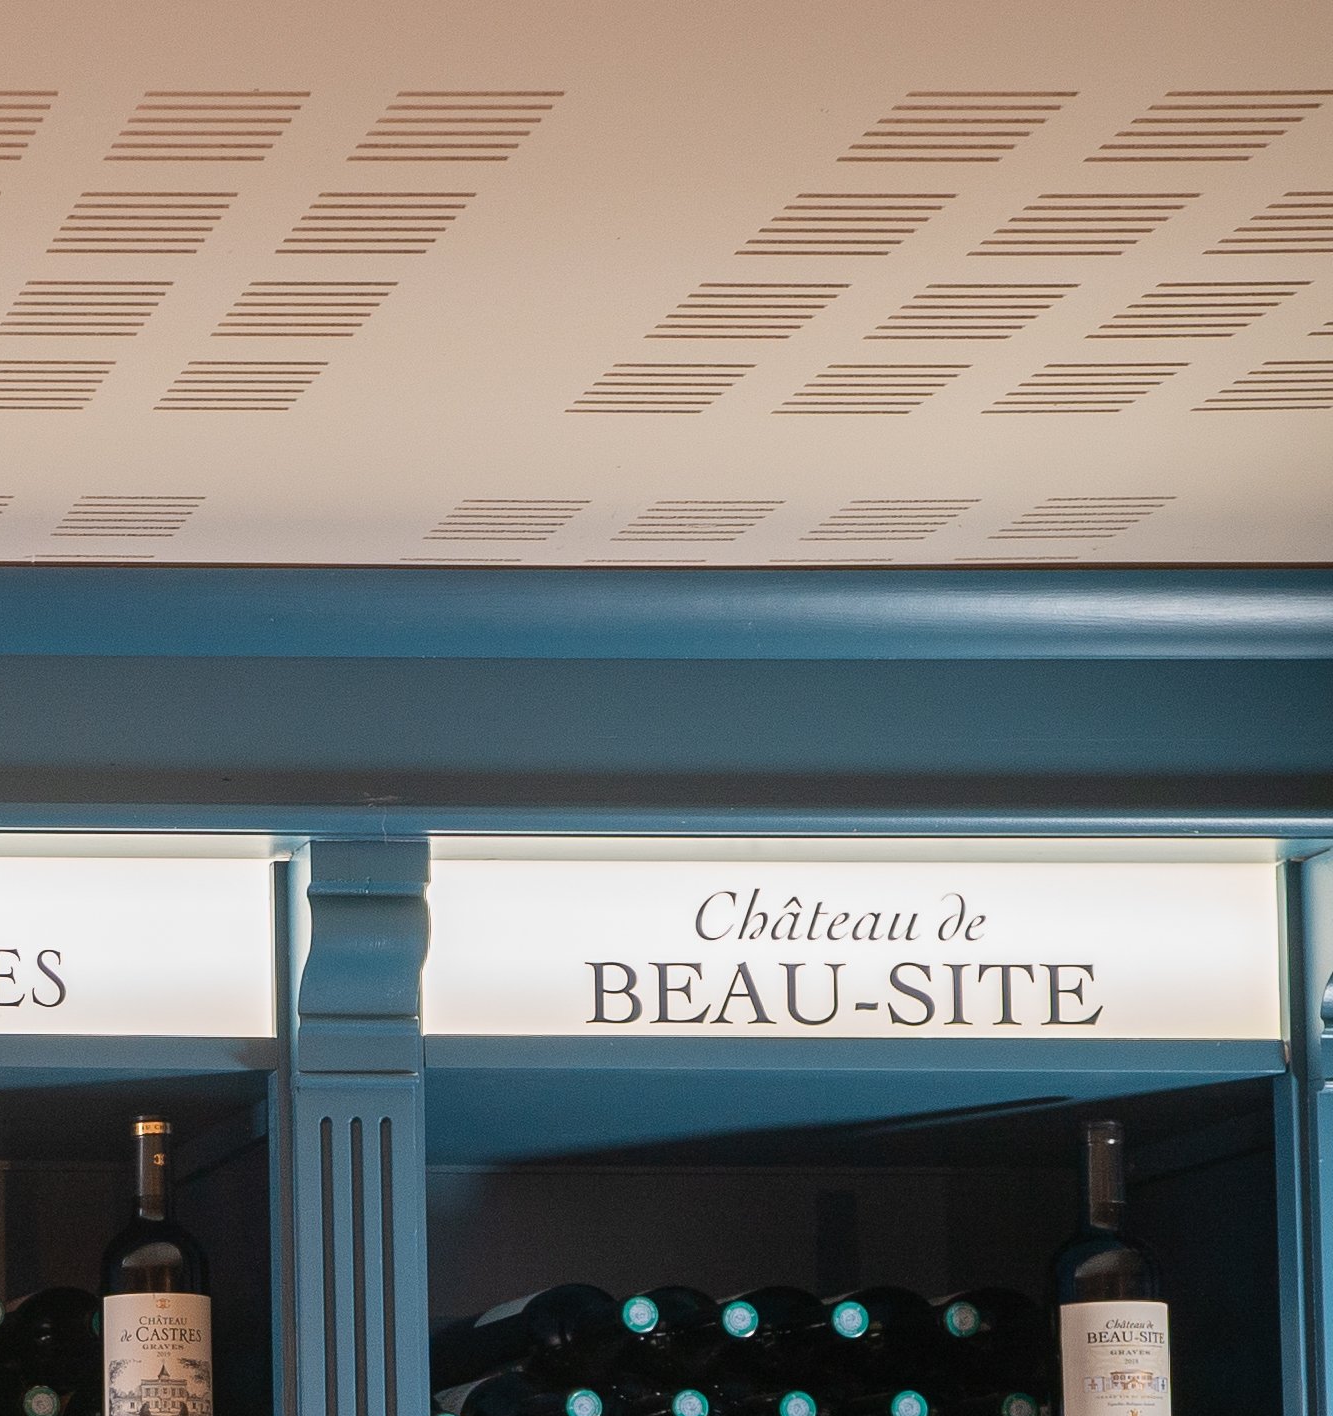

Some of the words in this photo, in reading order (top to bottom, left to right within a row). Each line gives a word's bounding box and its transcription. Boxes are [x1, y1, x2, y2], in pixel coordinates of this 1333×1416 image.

[694, 887, 921, 943] Château
[937, 892, 988, 942] de
[584, 960, 1104, 1026] BEAU-SITE
[139, 1314, 187, 1326] CHÂTEAU
[1105, 1319, 1145, 1330] Château
[120, 1330, 133, 1343] de
[135, 1326, 202, 1345] CASTRES
[1087, 1330, 1165, 1345] BEAU-SITE
[142, 1343, 185, 1351] GRAVES
